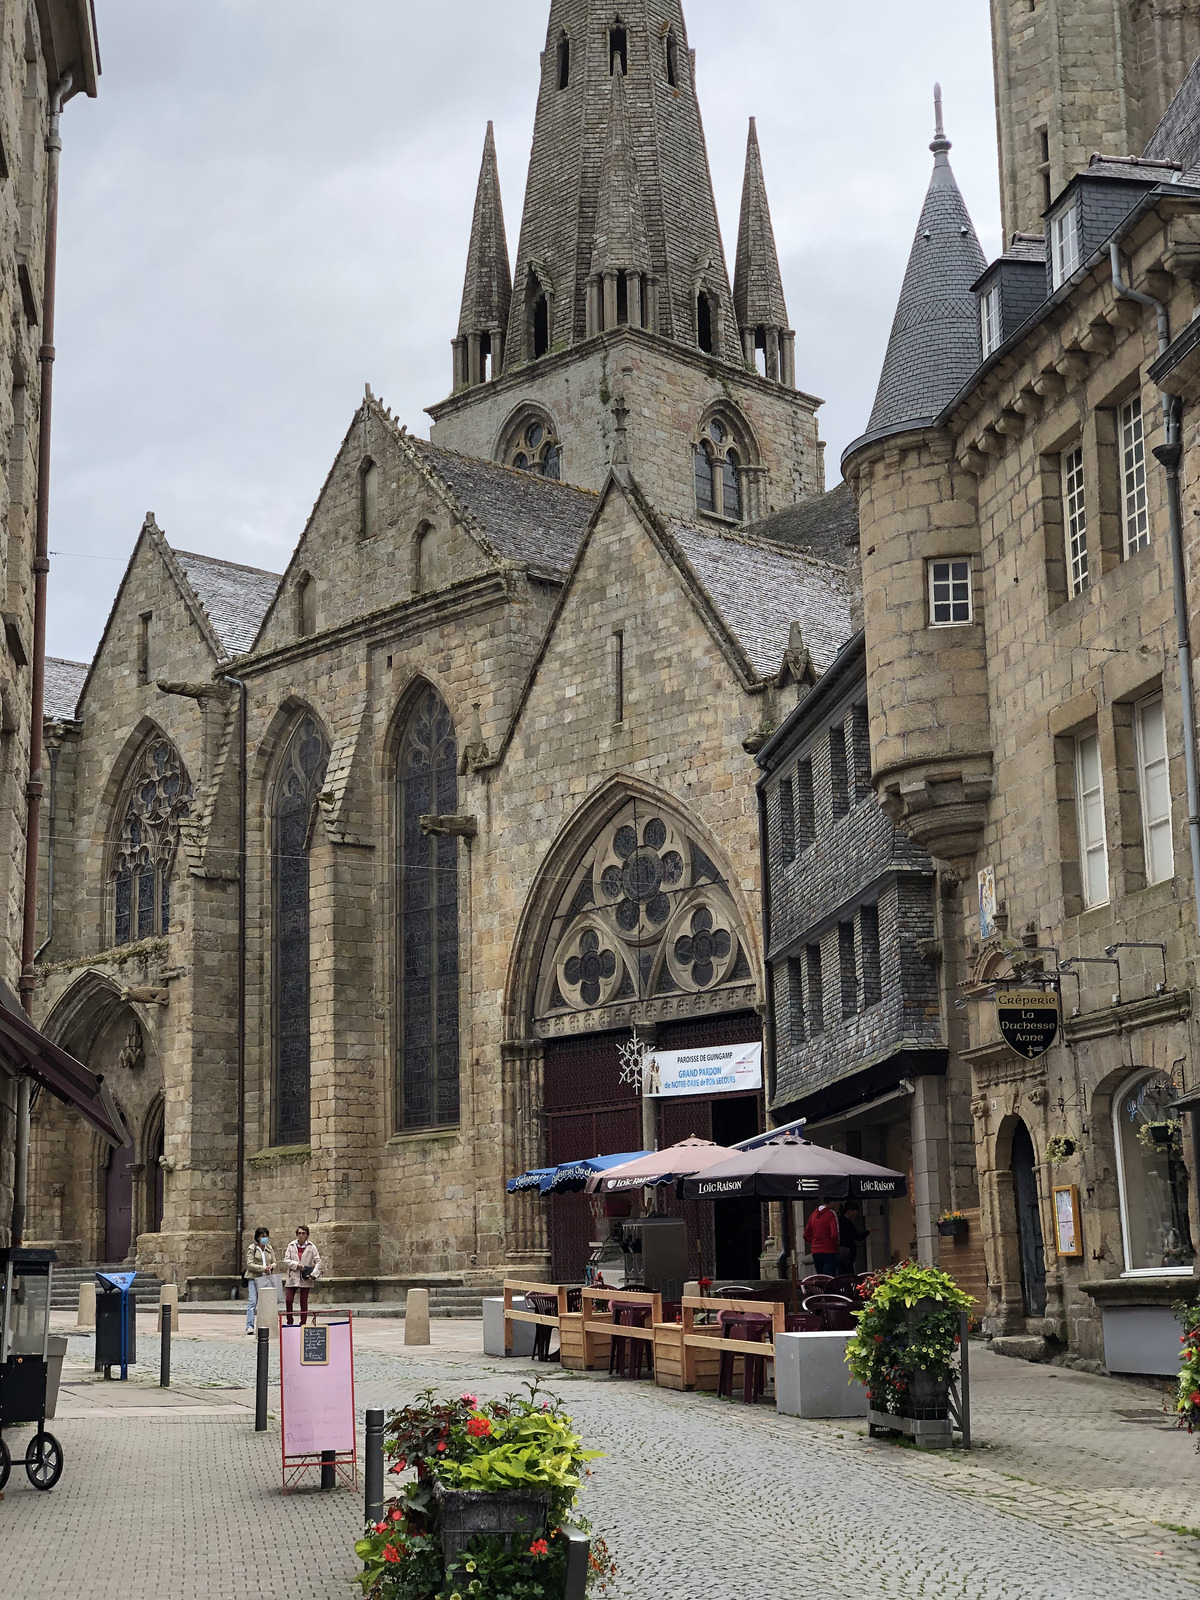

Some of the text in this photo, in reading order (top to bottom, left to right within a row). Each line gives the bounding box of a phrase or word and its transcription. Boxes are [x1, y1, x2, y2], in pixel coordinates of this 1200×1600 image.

[998, 994, 1056, 1007] Crêperie
[1021, 1010, 1035, 1019] La
[1001, 1021, 1055, 1030] Duchesse
[1015, 1033, 1044, 1042] Anne
[677, 1052, 733, 1063] PAROISSE DE GUINGAMP
[678, 1067, 721, 1078] GRAND PARDON
